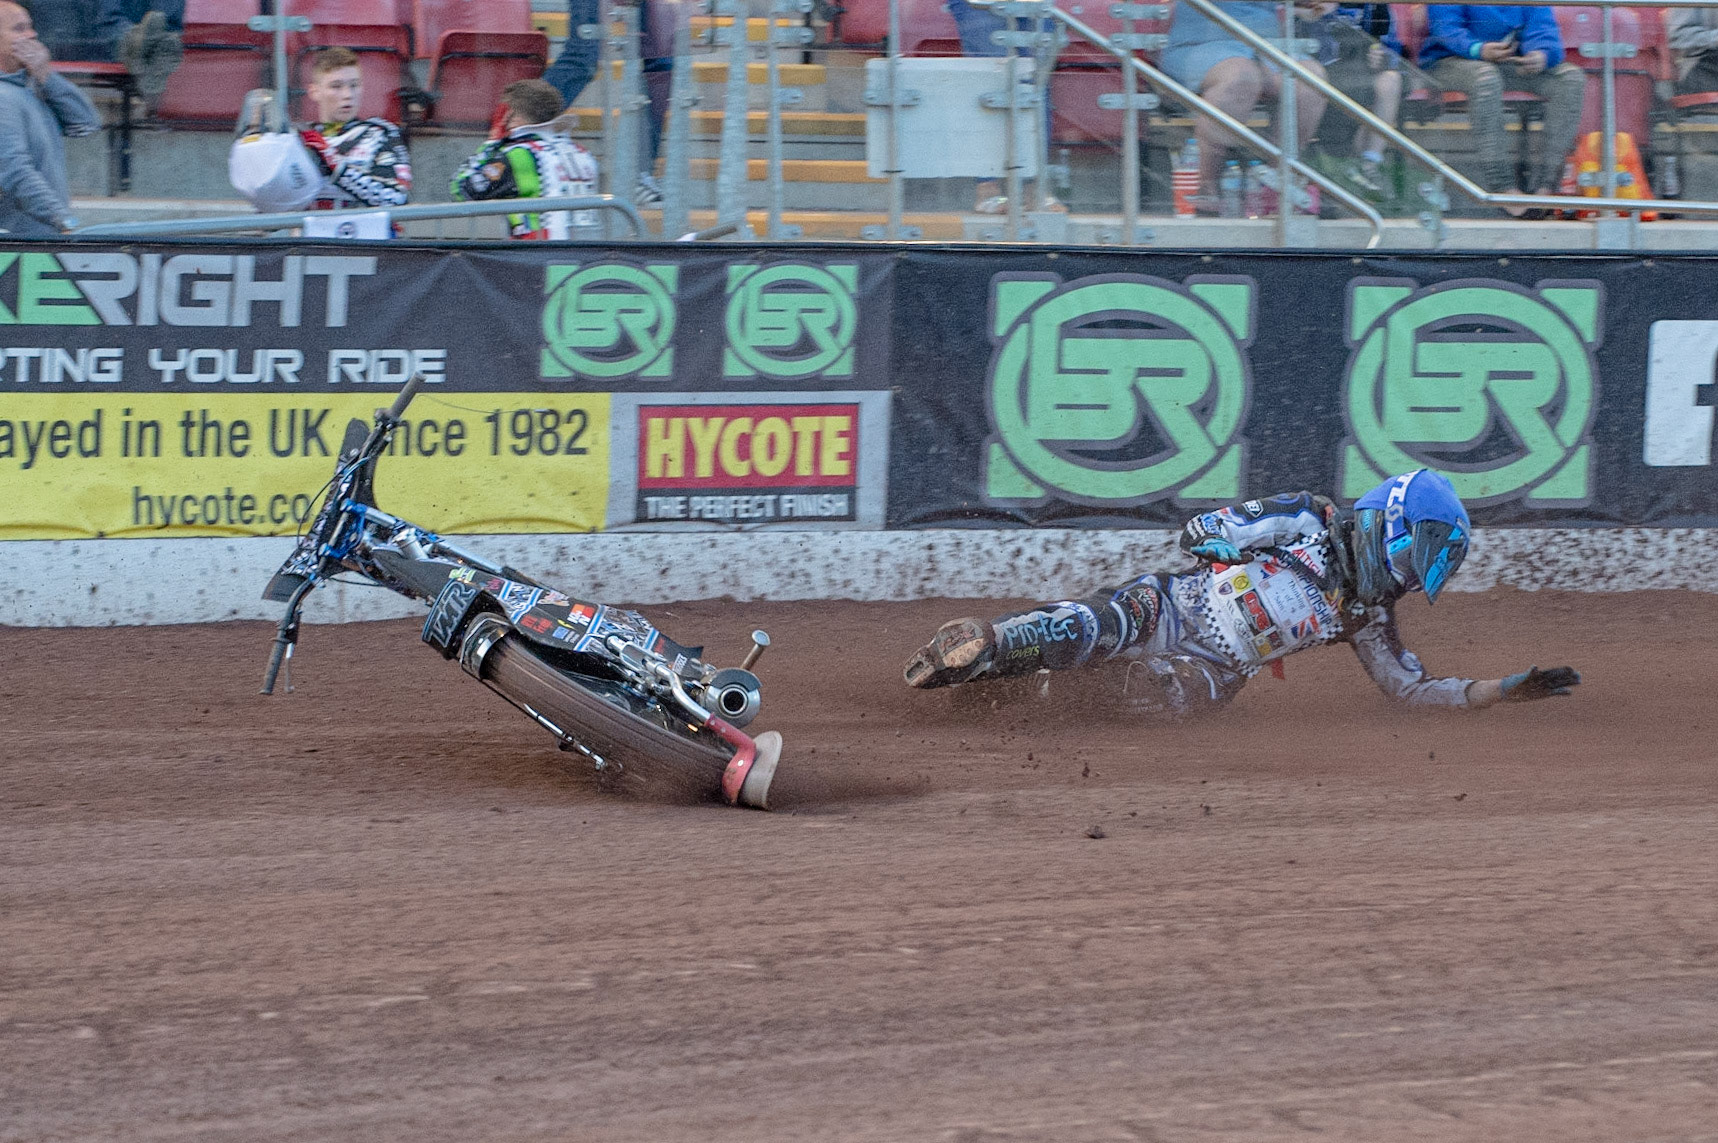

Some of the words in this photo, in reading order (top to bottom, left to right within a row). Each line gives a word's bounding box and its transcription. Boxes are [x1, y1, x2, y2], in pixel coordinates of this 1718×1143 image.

[0, 348, 125, 383] TING
[148, 348, 304, 384] YOUR
[328, 349, 448, 384] RIDE
[121, 408, 160, 457] in
[179, 408, 251, 457] the
[269, 408, 333, 457] UK
[382, 418, 468, 457] nce
[485, 408, 591, 457] 1982
[645, 416, 852, 478] HYCOTE
[644, 495, 688, 519] THE
[689, 495, 778, 519] PERFECT
[779, 493, 849, 518] FINISH
